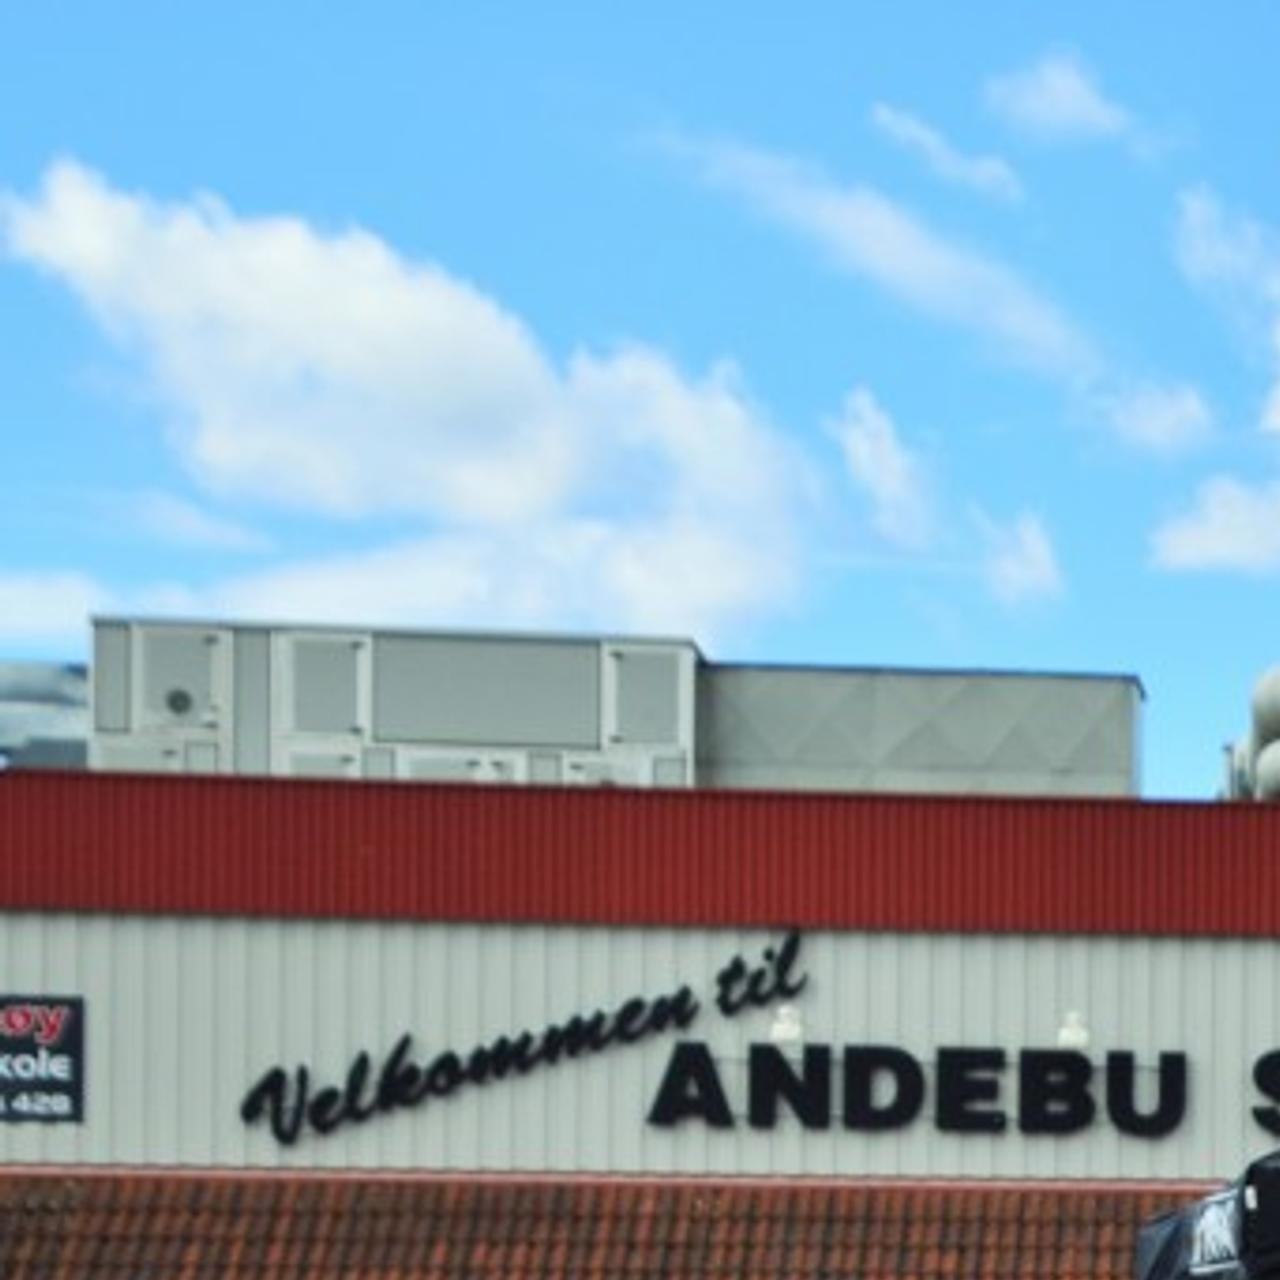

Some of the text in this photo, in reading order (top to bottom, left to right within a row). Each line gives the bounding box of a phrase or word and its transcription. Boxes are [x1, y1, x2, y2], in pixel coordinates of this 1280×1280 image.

[241, 930, 808, 1146] Velkommen til
[647, 1042, 1188, 1139] ANDEBU
